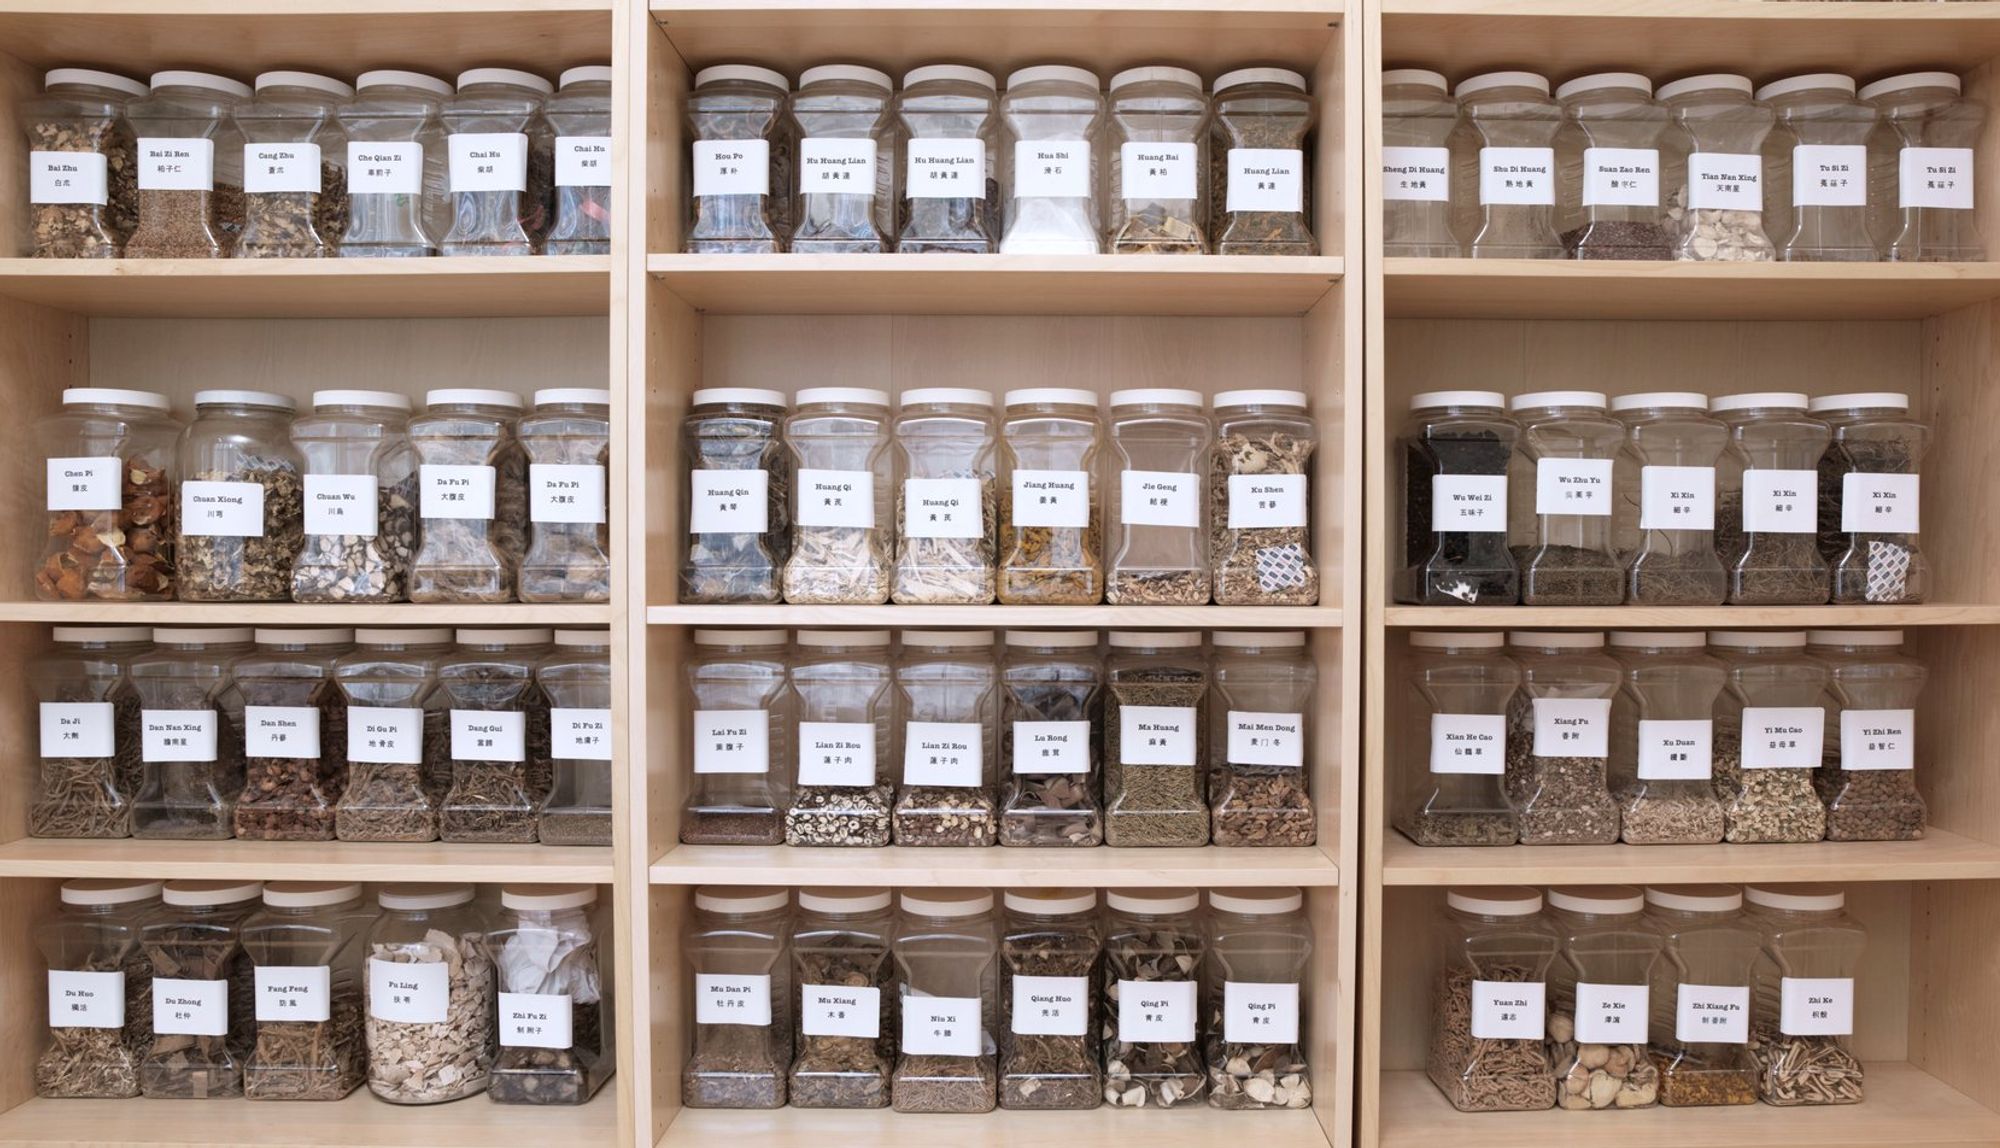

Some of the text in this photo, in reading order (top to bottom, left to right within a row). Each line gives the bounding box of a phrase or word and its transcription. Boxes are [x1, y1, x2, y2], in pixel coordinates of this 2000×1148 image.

[164, 150, 173, 158] Zi
[258, 152, 278, 160] Cang
[374, 154, 392, 162] Qian
[1137, 154, 1164, 162] Huang
[820, 157, 847, 166] Huang
[928, 157, 955, 165] Huang
[48, 164, 61, 172] Bai
[1244, 168, 1270, 176] Huang
[1419, 166, 1445, 175] Huang
[1520, 166, 1546, 174] Huang
[1738, 174, 1757, 182] Xing
[1573, 476, 1588, 484] Zhu
[815, 483, 852, 492] Huang Qi
[1023, 481, 1075, 490] Jiang Huang
[1157, 483, 1177, 492] Geng
[707, 489, 749, 497] Huang Qin
[1251, 486, 1263, 494] Ku
[217, 496, 243, 505] Xiong
[1554, 718, 1577, 726] Xiang
[183, 724, 202, 732] Xing
[376, 725, 387, 733] Gu
[468, 725, 488, 733] Dang
[1153, 724, 1179, 733] Huang
[1275, 724, 1296, 733] Dong
[1047, 734, 1068, 743] Rong
[267, 986, 288, 994] Fang
[400, 982, 418, 991] Ling
[177, 998, 201, 1007] Zhong
[833, 997, 856, 1006] Xiang
[1031, 995, 1054, 1003] Qiang
[1140, 1000, 1159, 1008] Qing
[1706, 1003, 1728, 1011] Xiang
